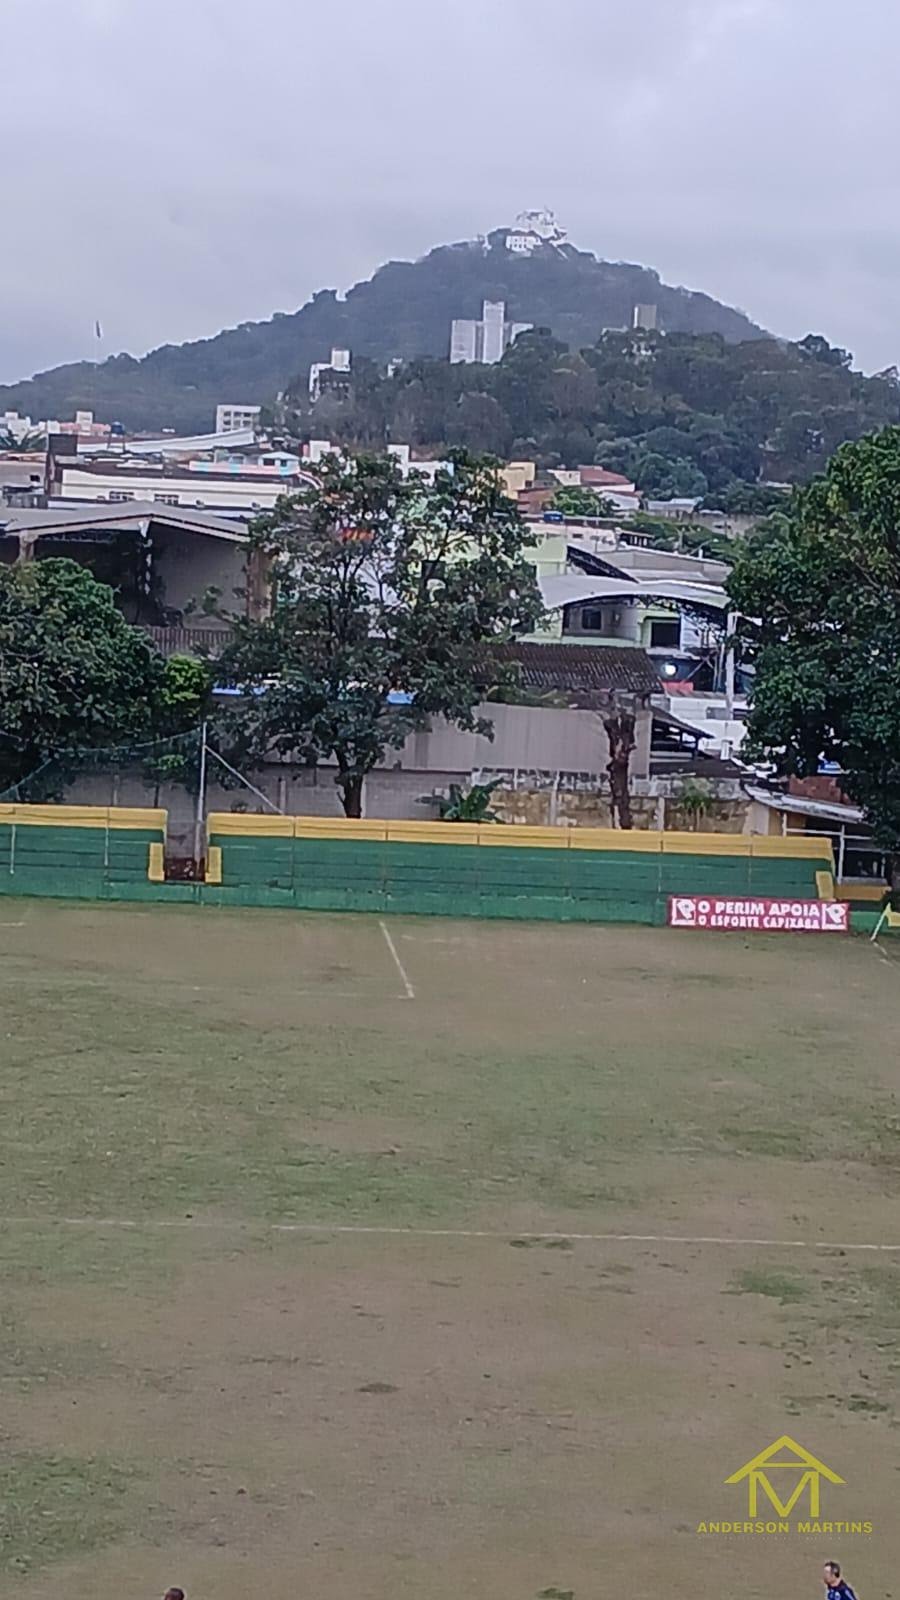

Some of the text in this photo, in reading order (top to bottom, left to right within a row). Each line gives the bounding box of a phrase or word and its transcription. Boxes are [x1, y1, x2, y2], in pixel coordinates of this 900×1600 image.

[698, 901, 820, 916] O PERIM APOIA
[698, 915, 707, 926] O
[711, 915, 759, 927] ESPORTE
